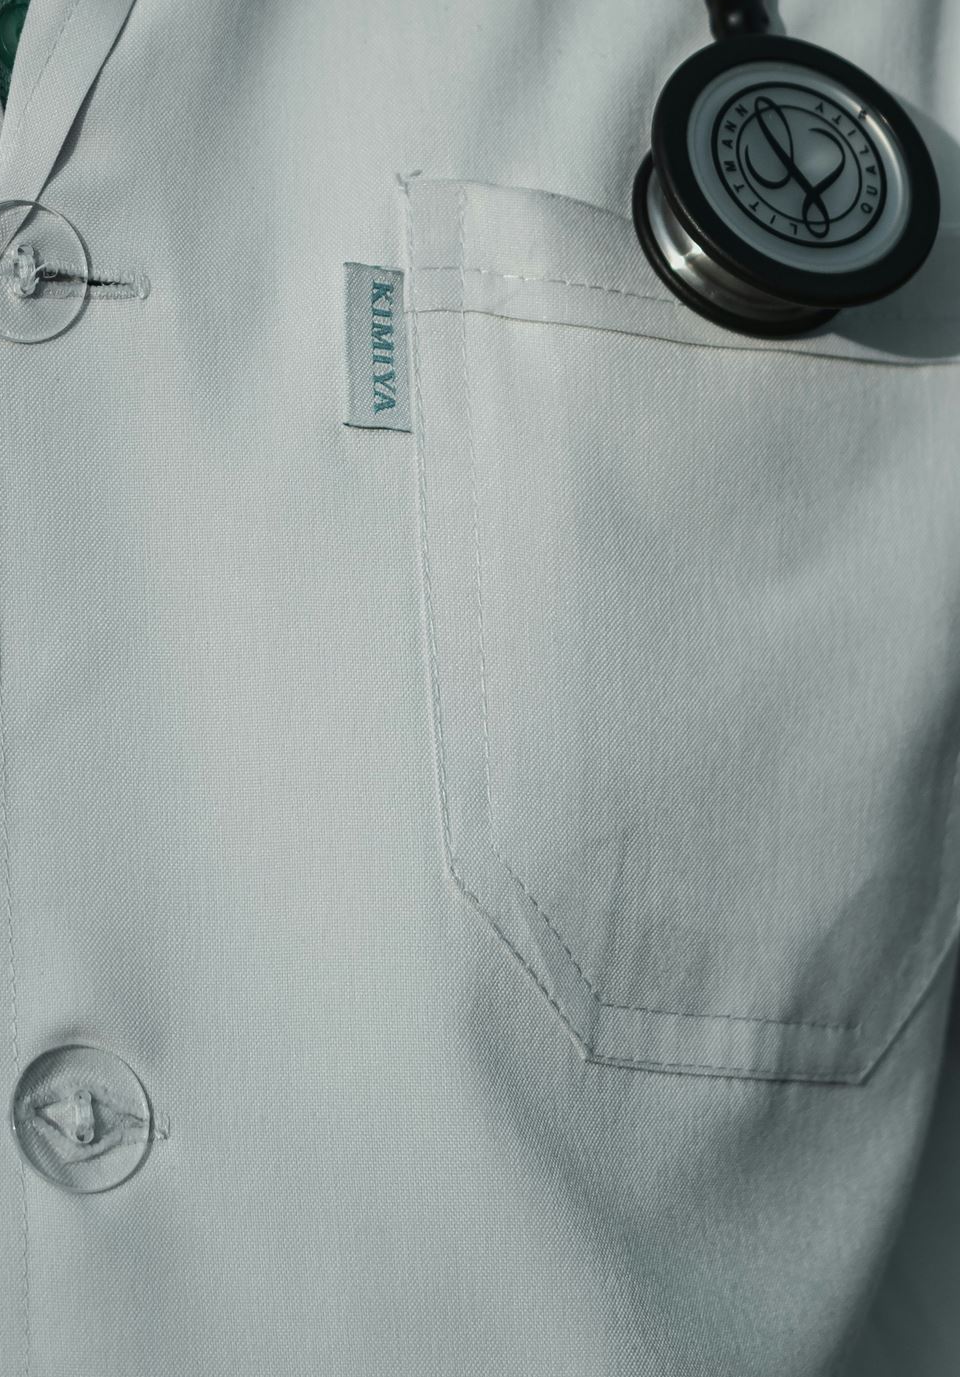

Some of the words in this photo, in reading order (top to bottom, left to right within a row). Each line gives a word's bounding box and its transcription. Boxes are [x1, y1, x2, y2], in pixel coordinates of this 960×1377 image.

[721, 103, 798, 235] LITTMANN
[814, 101, 879, 215] QUALITY
[370, 279, 396, 415] KIMIYA
